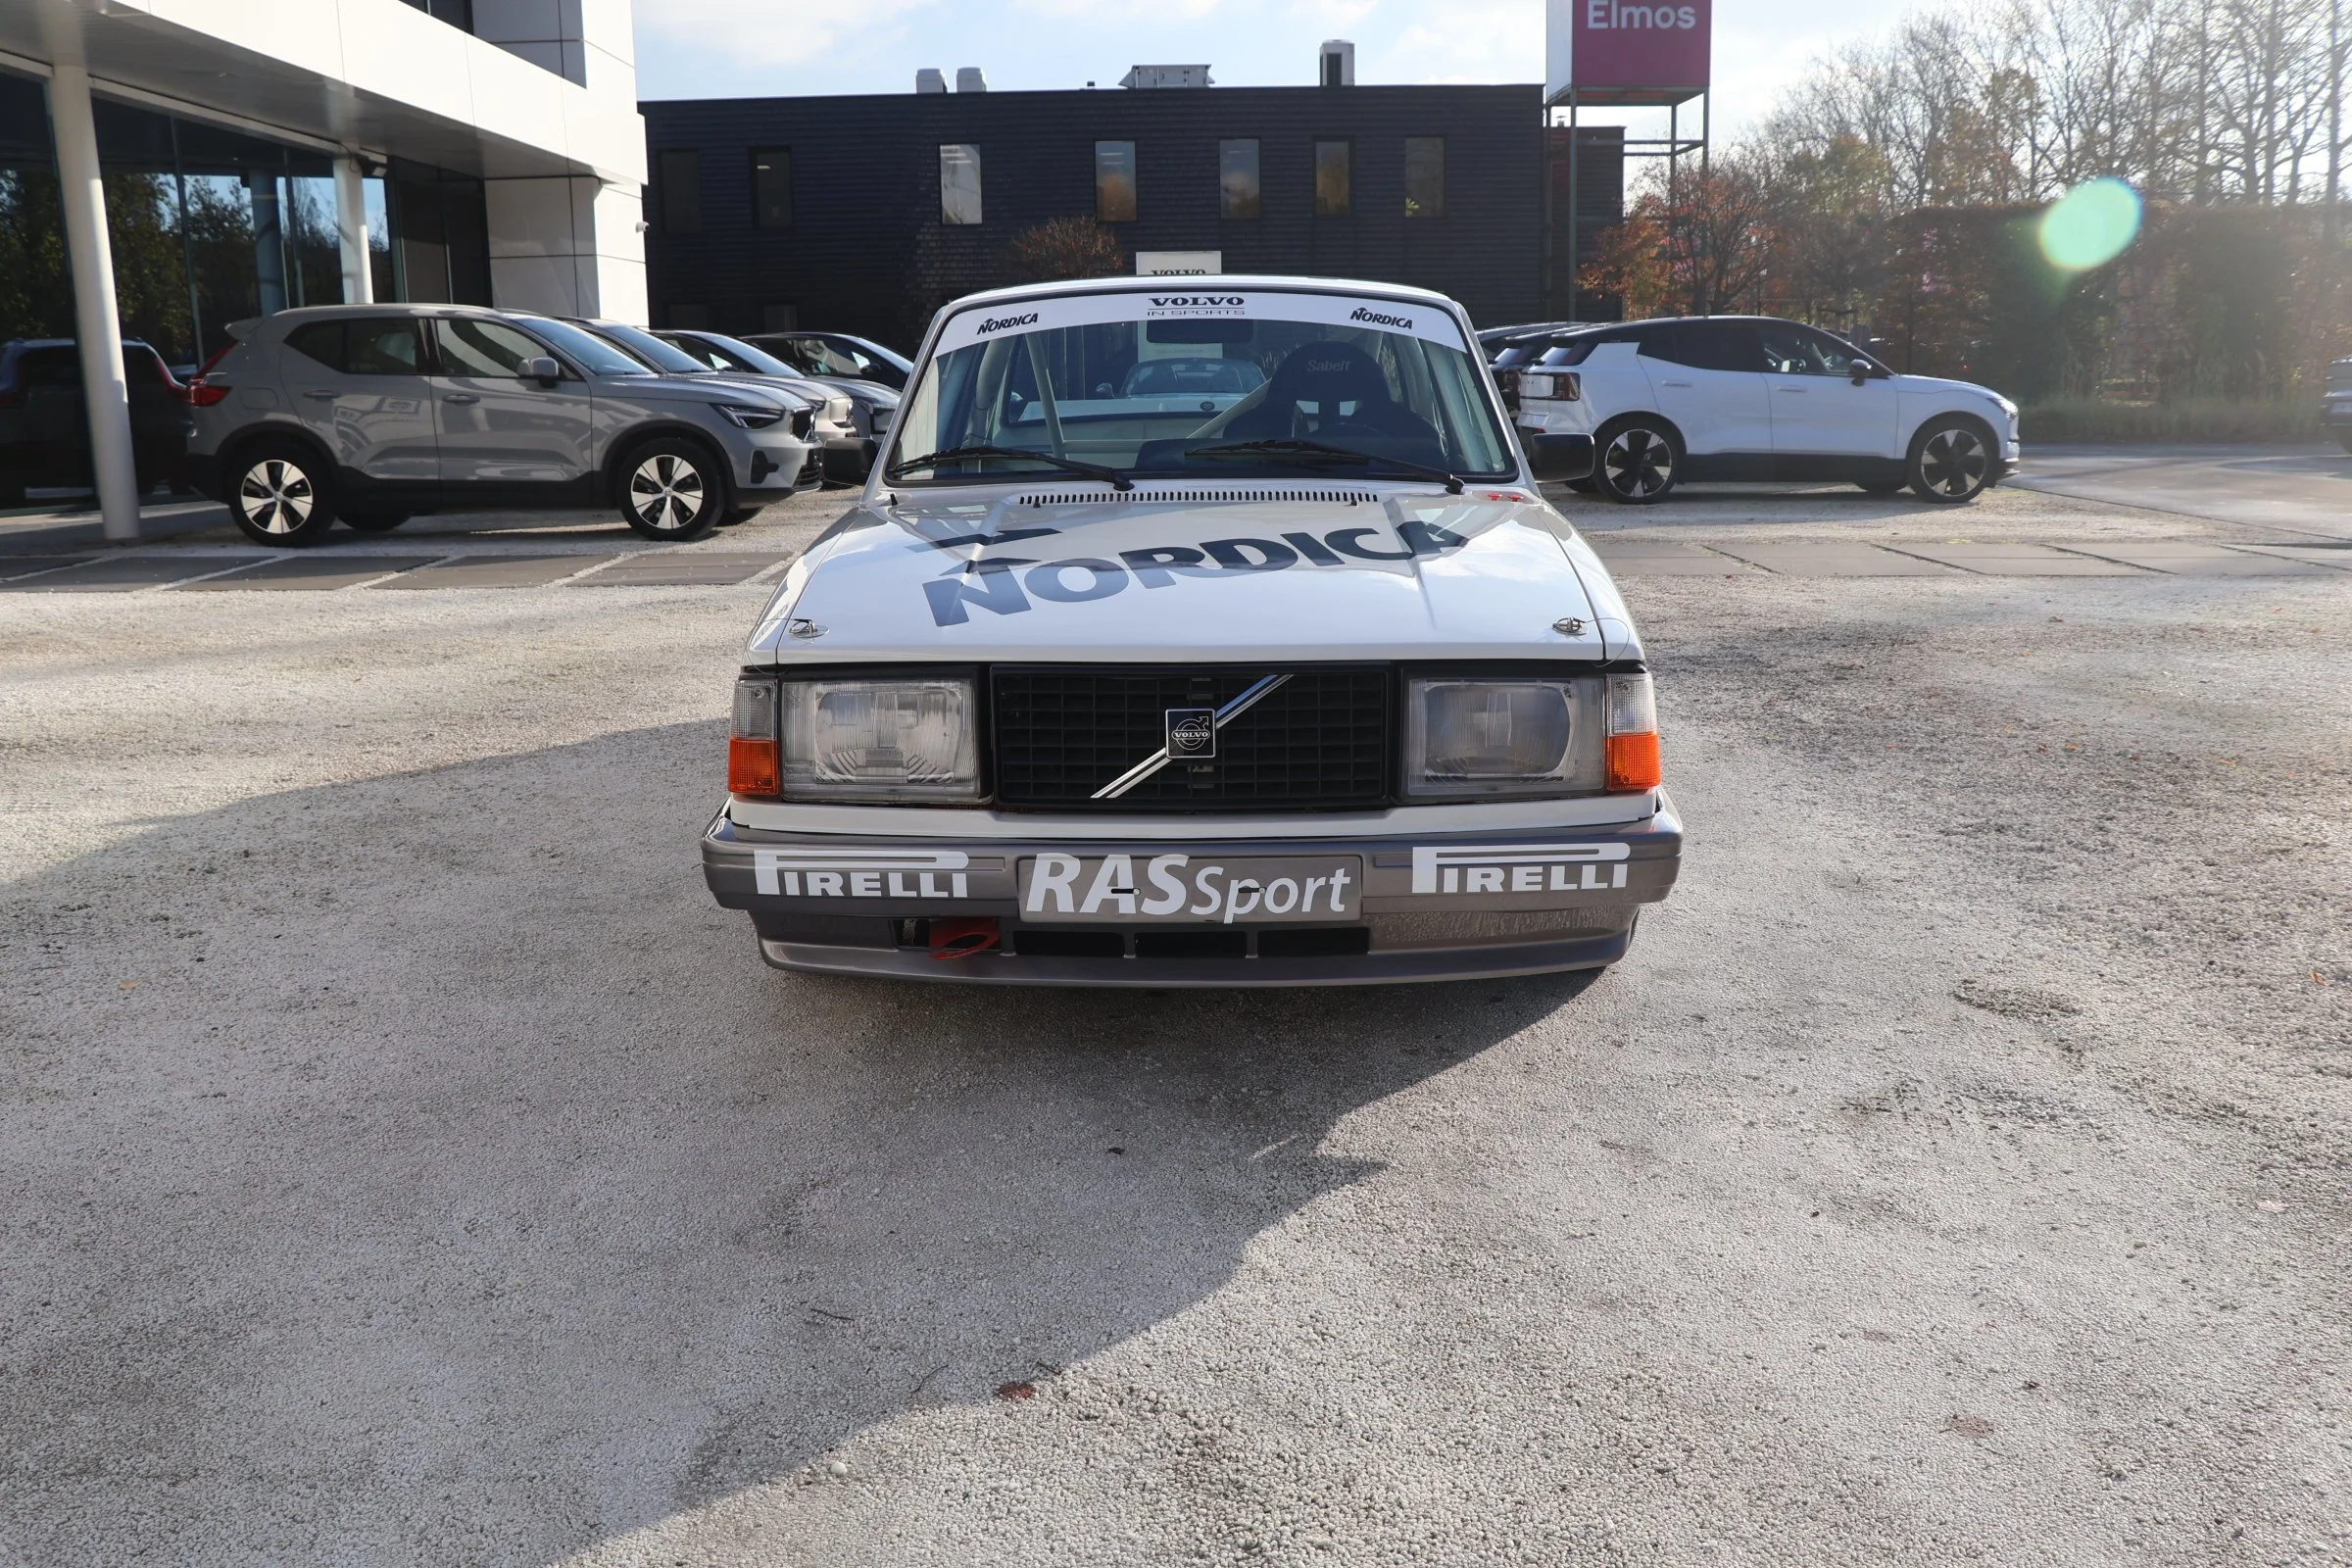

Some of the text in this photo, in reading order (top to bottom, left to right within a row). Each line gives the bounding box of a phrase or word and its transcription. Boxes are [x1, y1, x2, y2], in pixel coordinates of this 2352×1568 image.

[1587, 0, 1696, 29] Elmos
[1148, 296, 1245, 306] VOLVO
[976, 313, 1039, 335] NORDICA
[1349, 307, 1413, 330] NORDICA
[905, 520, 1468, 627] NORDICA
[754, 850, 969, 899] PIRELLI
[1412, 842, 1631, 893] PIRELLI
